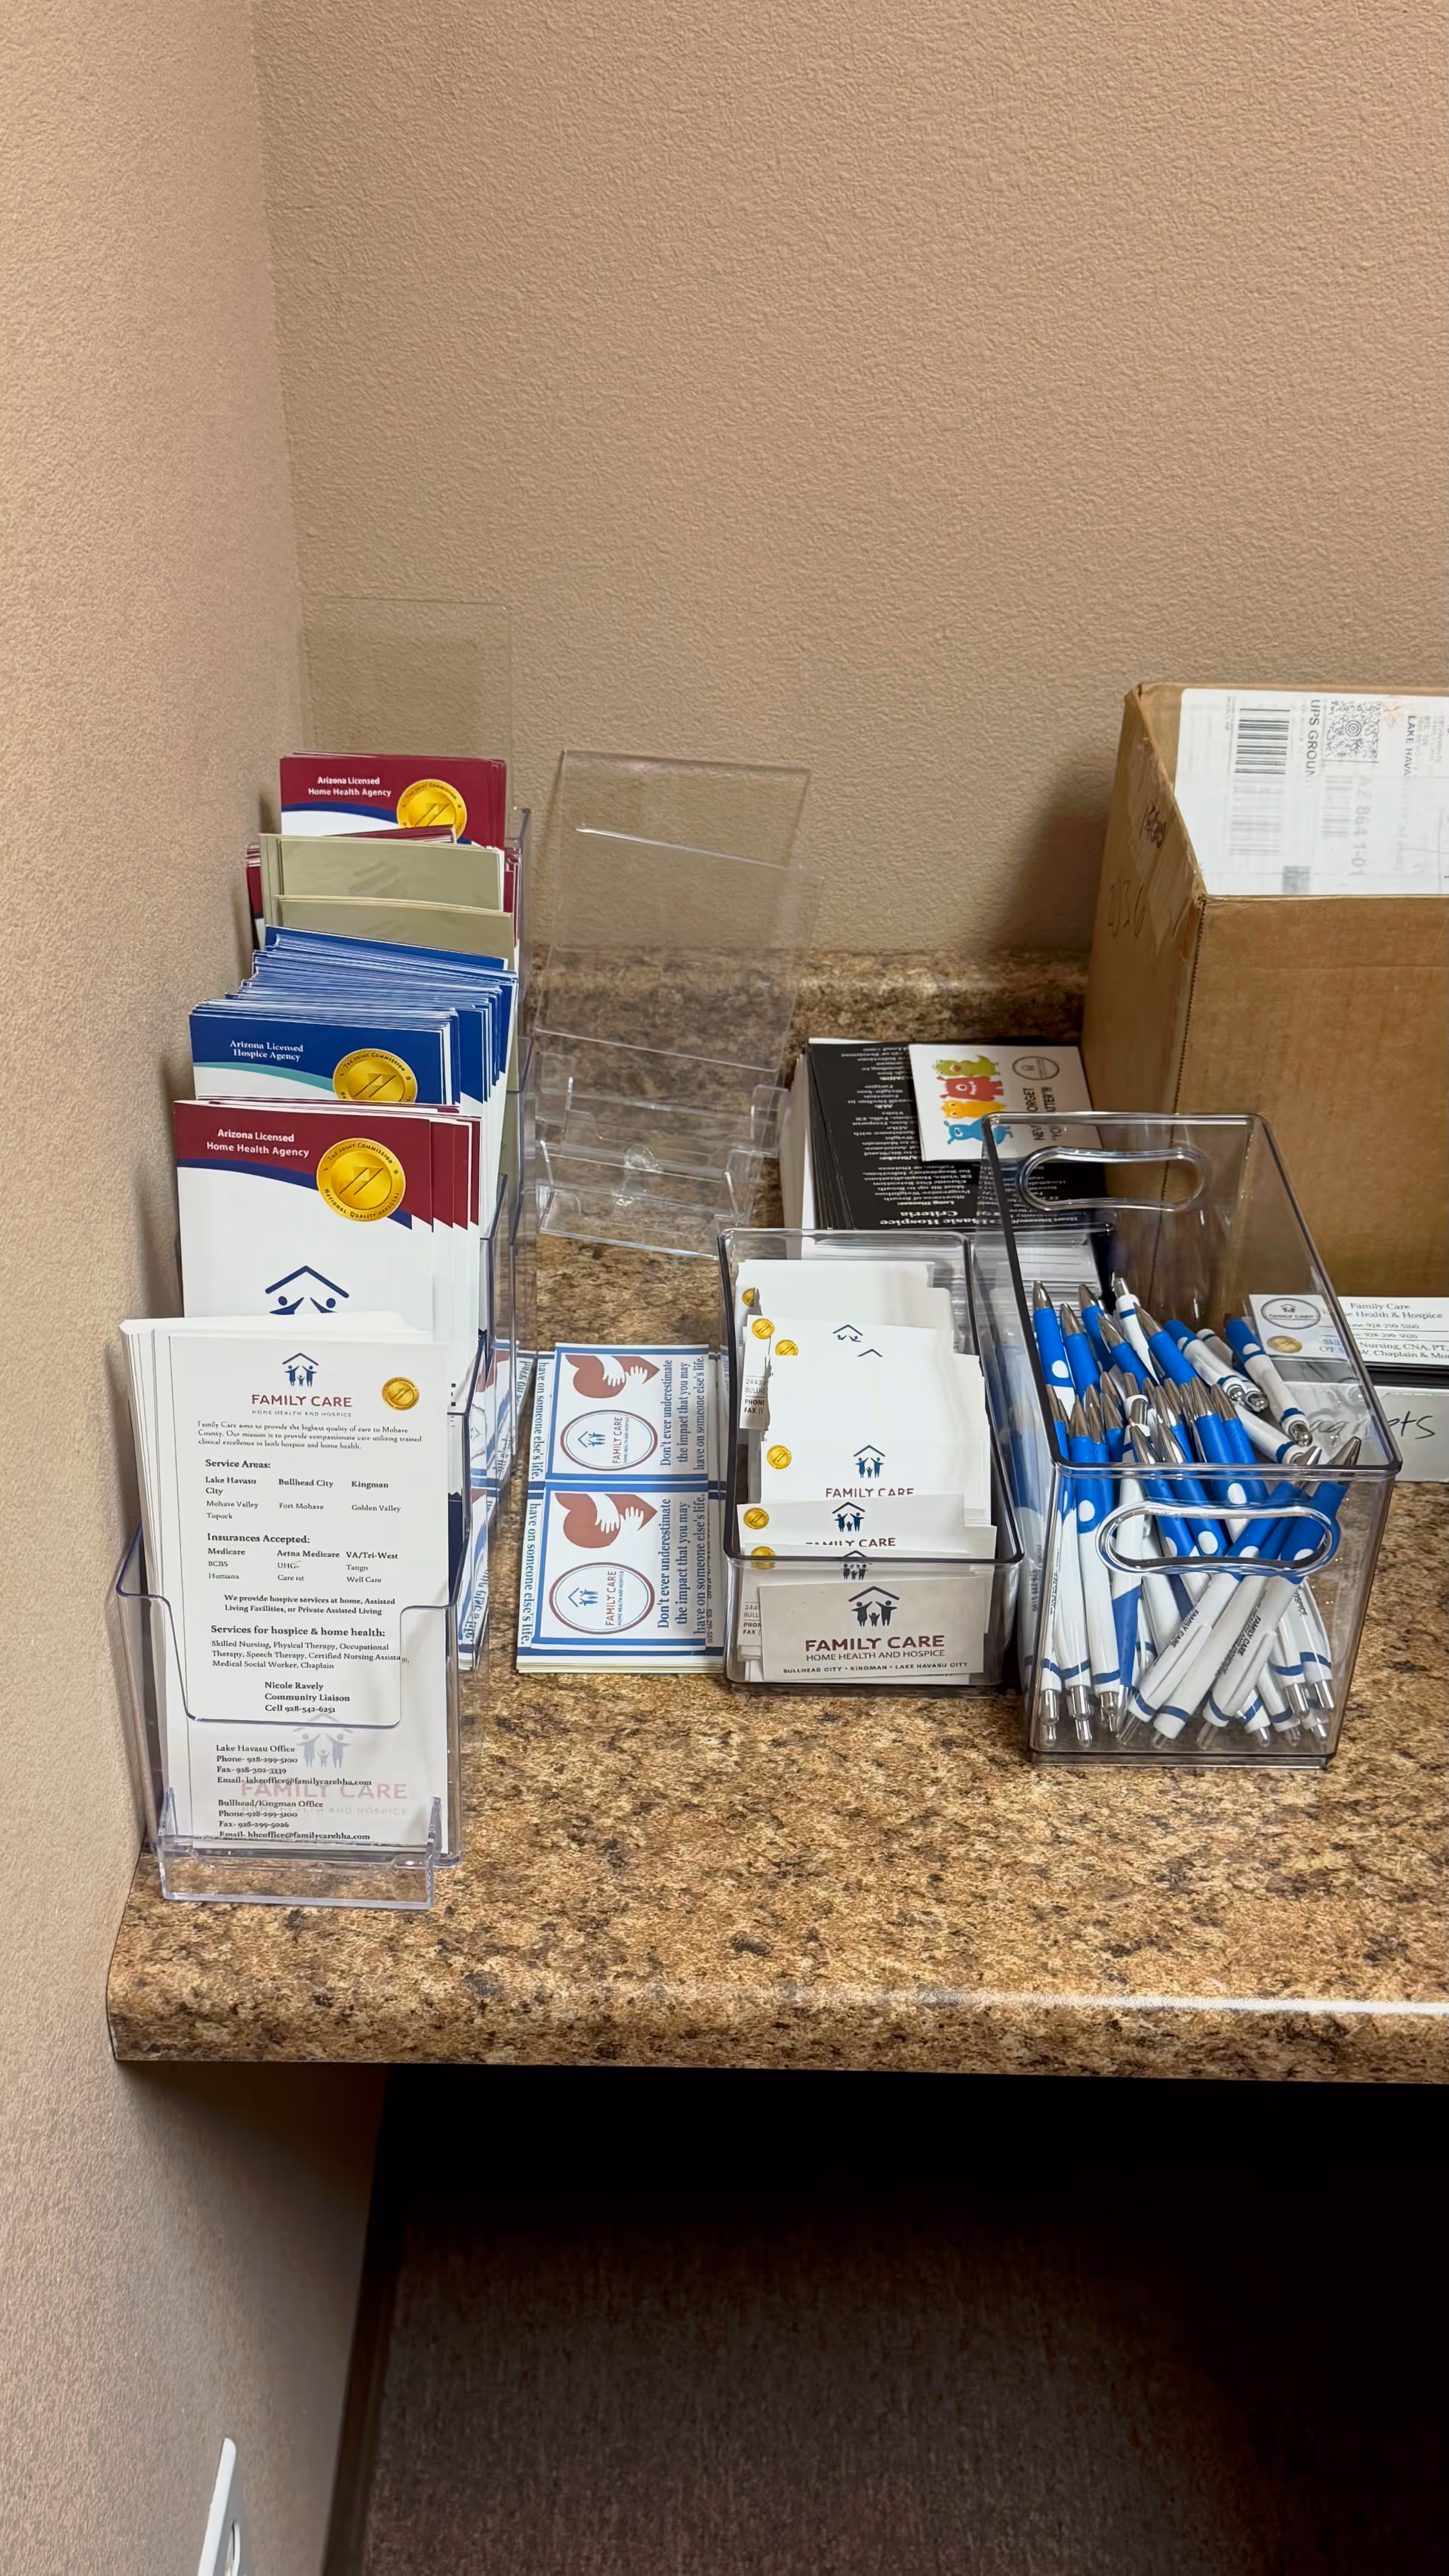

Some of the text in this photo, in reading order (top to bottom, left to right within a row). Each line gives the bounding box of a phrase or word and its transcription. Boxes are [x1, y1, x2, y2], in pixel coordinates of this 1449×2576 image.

[1309, 700, 1321, 725] UPS
[1405, 716, 1416, 744] LAKE
[318, 777, 346, 785] Arizona
[362, 789, 392, 798] Agency
[230, 1040, 303, 1053] Arizona Licensed
[233, 1048, 301, 1063] Hospice Agency
[217, 1128, 294, 1143] Arizona Licensed
[207, 1141, 309, 1158] Home Health Agency
[660, 1360, 672, 1417] underestimate
[251, 1395, 352, 1408] FAMILY CARE
[677, 1362, 691, 1463] the impact that you may
[693, 1356, 705, 1470] have on someone else's life.
[531, 1362, 549, 1479] have on someone else's life.
[612, 1417, 622, 1463] FAMILY CARE
[660, 1442, 671, 1466] Don't
[205, 1487, 223, 1496] City
[351, 1481, 389, 1489] Kingman
[826, 1488, 915, 1498] FAMILY CARE
[379, 1505, 401, 1513] Valley
[207, 1533, 310, 1545] Insurances Accepted:
[657, 1498, 671, 1628] Don't ever underestimate
[675, 1502, 691, 1625] the impact that you may
[693, 1494, 706, 1635] have on someone else's life.
[521, 1503, 541, 1645] have on someone else's life.
[605, 1571, 616, 1626] FAMILY CARE
[225, 1605, 248, 1613] Living
[251, 1605, 287, 1613] Facilities,
[359, 1608, 382, 1616] Living
[211, 1625, 251, 1633] Services
[254, 1625, 269, 1634] for
[271, 1627, 308, 1636] hospice
[321, 1627, 349, 1636] home
[351, 1628, 386, 1637] health:
[1170, 1609, 1198, 1648] FAMILY CARE
[1237, 1615, 1261, 1656] FAMILY CARE
[273, 1642, 303, 1650] Physical
[304, 1642, 337, 1651] Therapy,
[805, 1635, 945, 1651] FAMILY CARE
[295, 1682, 324, 1691] Ravely
[265, 1693, 317, 1702] Community
[285, 1705, 336, 1713] 928-542-6251
